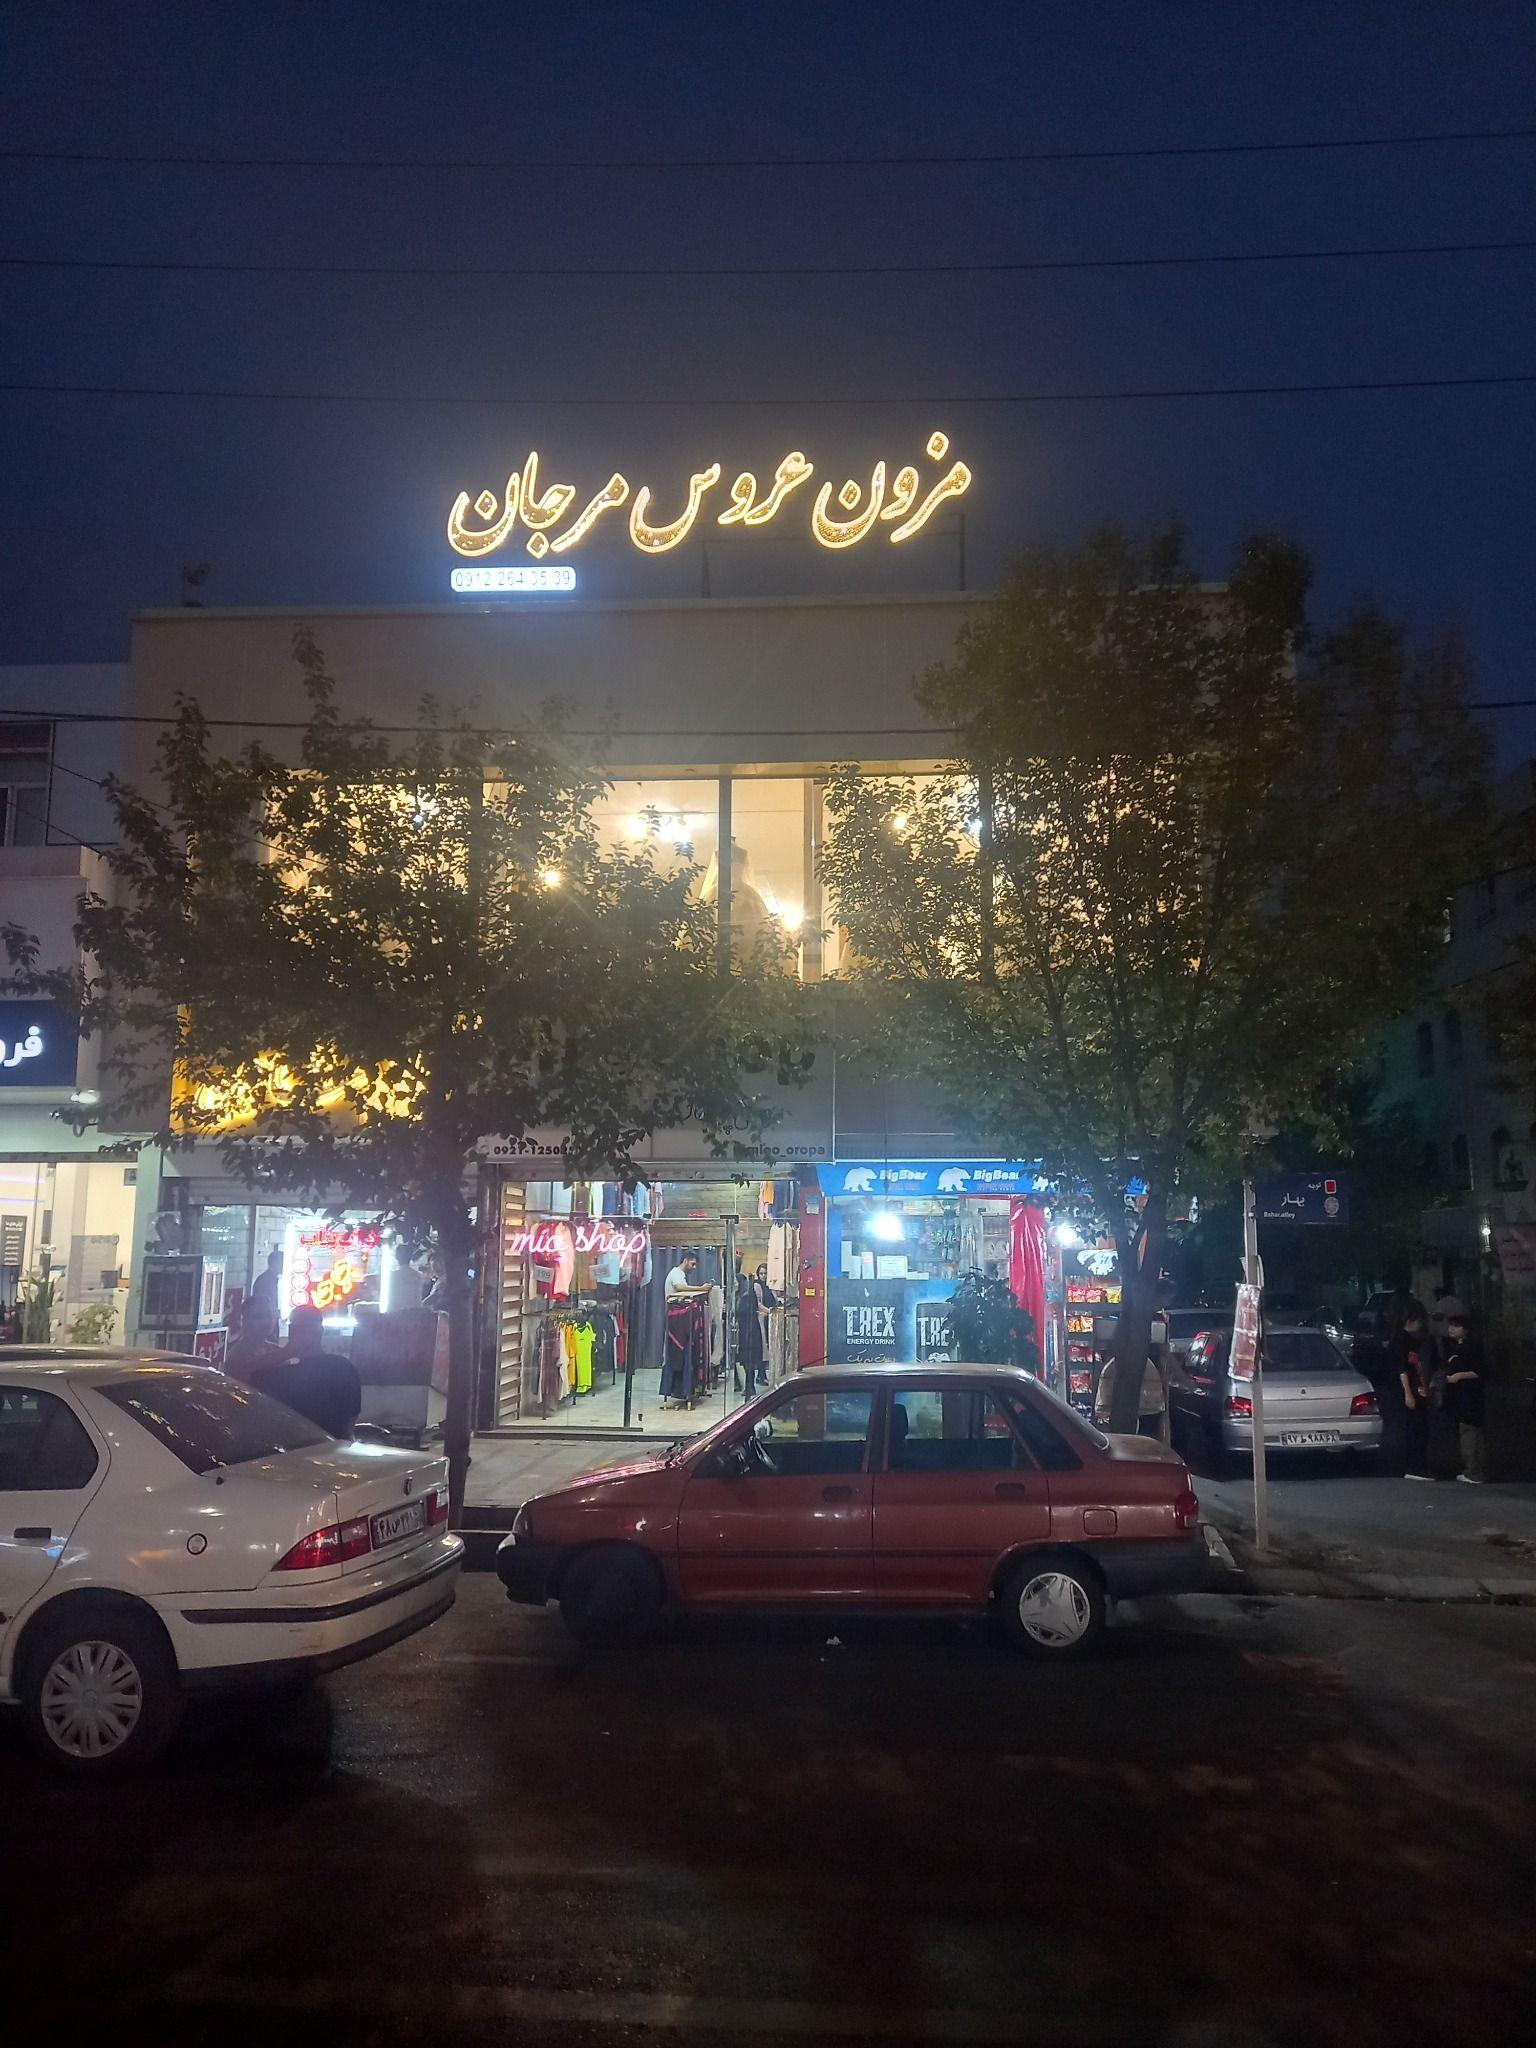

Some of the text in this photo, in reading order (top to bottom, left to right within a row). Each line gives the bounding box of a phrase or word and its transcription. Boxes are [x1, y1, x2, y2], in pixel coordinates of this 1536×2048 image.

[446, 431, 973, 559] مزون عروس مرجان
[0, 1025, 44, 1067] فر
[509, 1218, 647, 1269] mio shop
